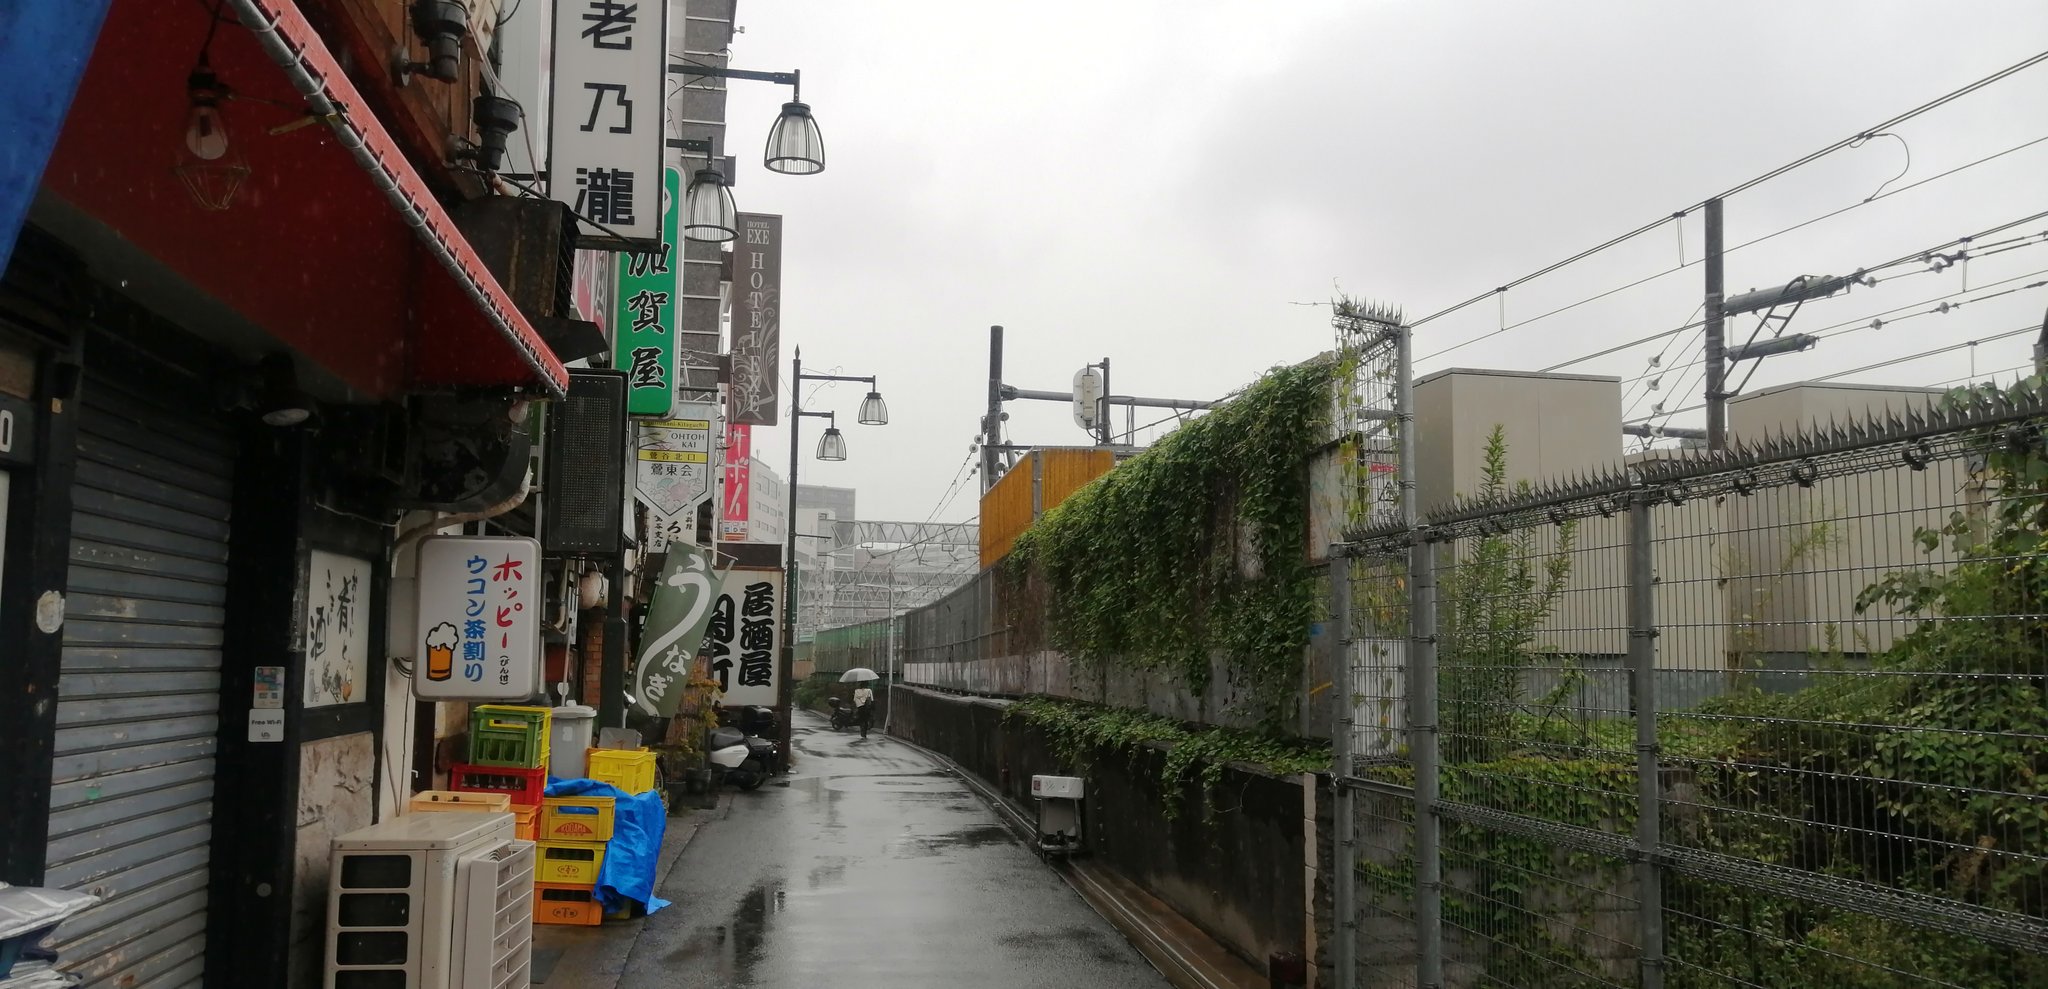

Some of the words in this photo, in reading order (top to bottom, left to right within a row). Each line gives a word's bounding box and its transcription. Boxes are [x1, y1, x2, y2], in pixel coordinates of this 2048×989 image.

[574, 0, 638, 225] 老乃瀧
[747, 221, 770, 229] HOTEL
[747, 229, 770, 245] EXE
[626, 243, 672, 390] 加賀屋
[749, 252, 765, 349] HOTEL
[747, 355, 762, 413] EXE
[671, 432, 705, 441] OHTOH
[463, 555, 488, 683] ウコン茶割り
[493, 552, 523, 649] ホッピー
[636, 553, 712, 717] うなぎ
[738, 581, 775, 688] 居酒屋
